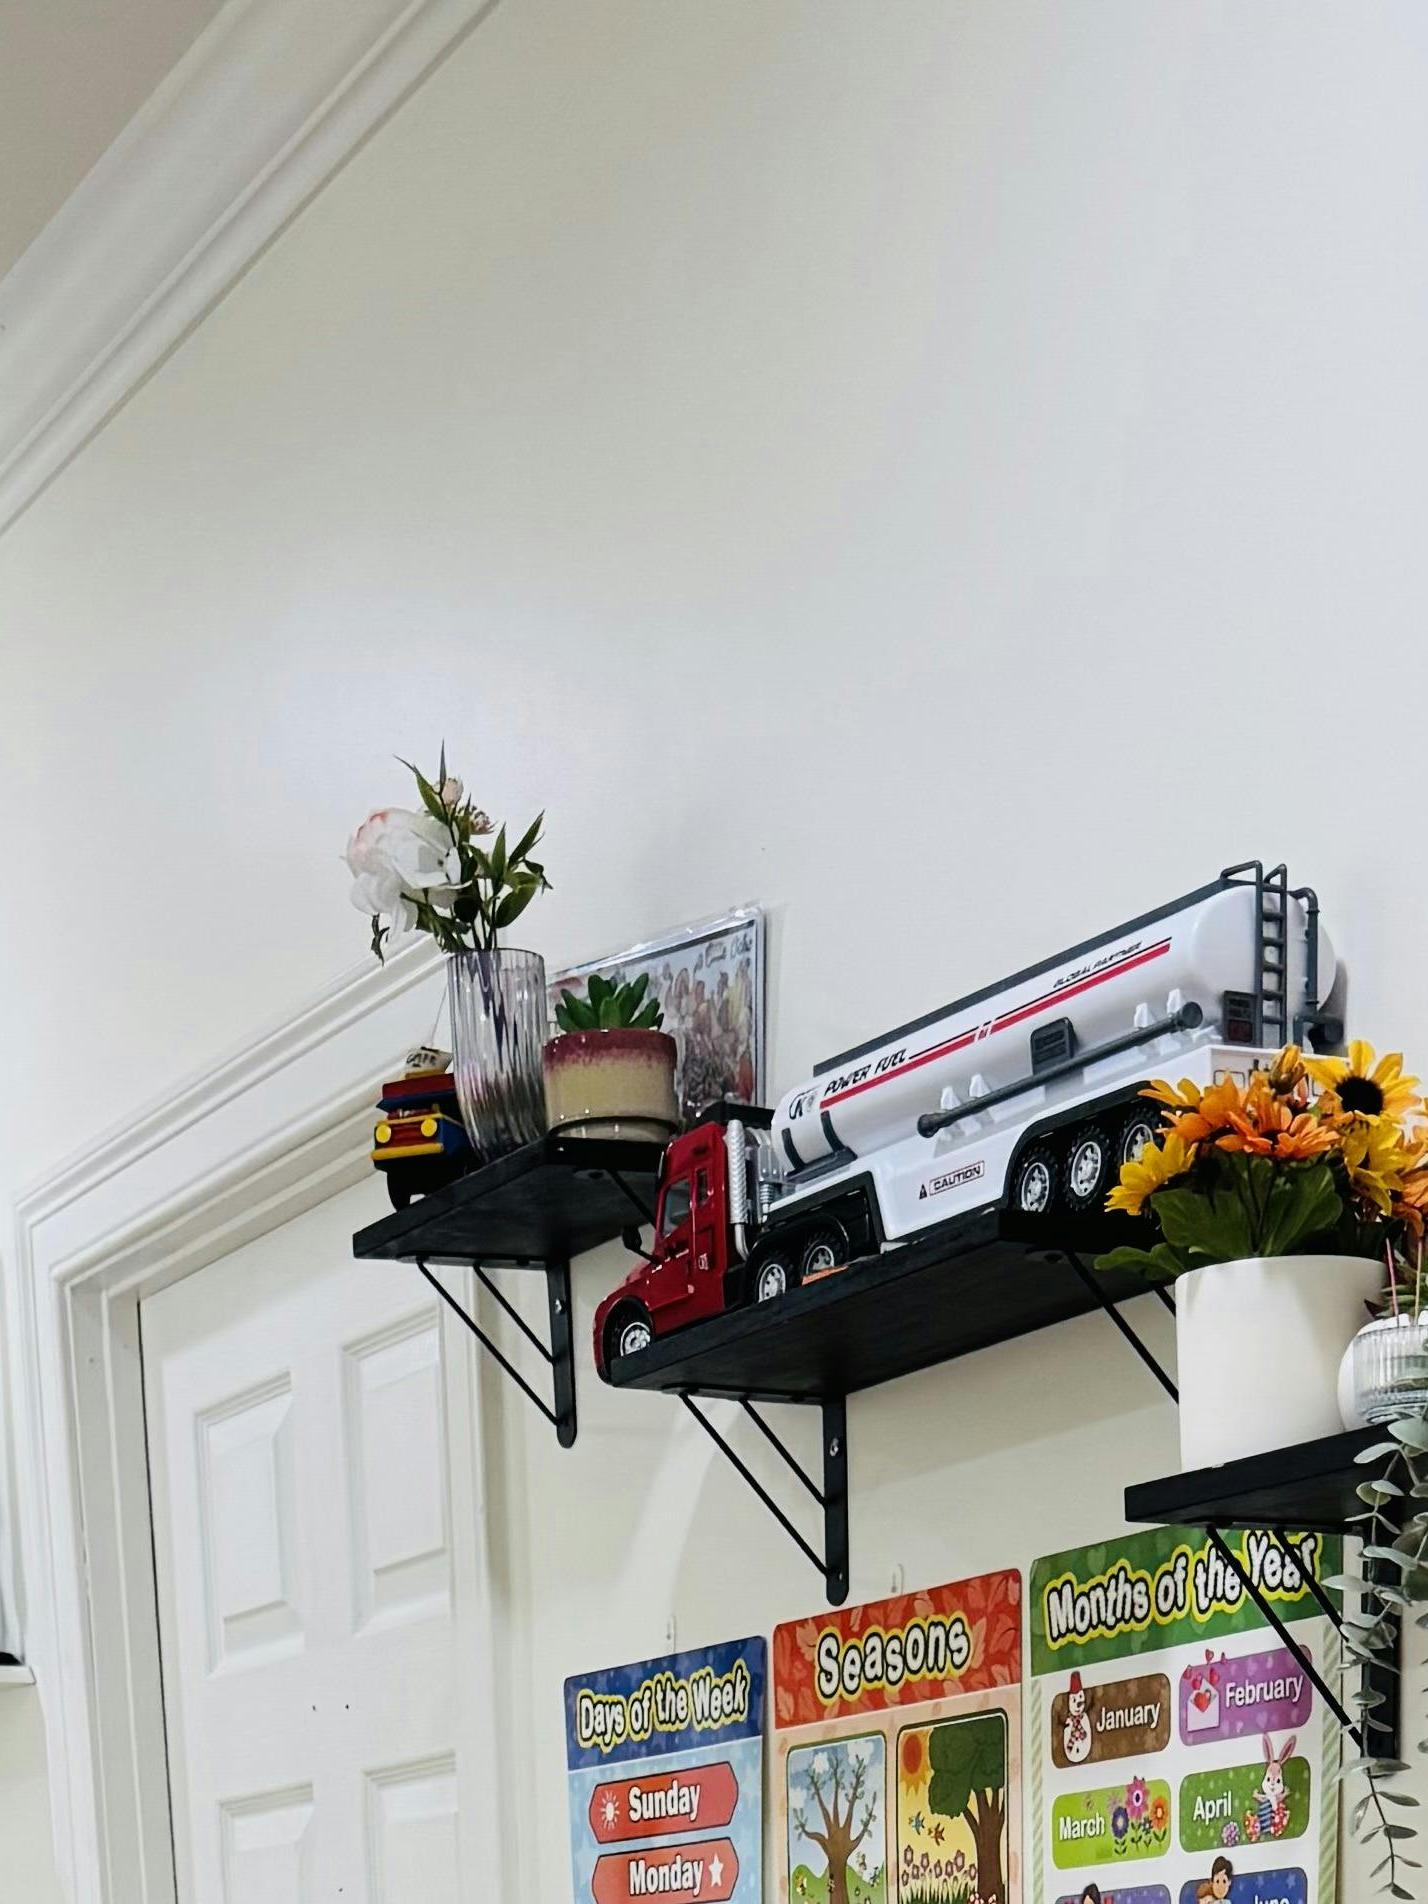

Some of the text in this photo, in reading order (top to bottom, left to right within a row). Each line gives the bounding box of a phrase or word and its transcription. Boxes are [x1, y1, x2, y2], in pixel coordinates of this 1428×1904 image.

[824, 1048, 907, 1096] POWER FUEL
[933, 1165, 981, 1191] CAUTION
[1047, 1532, 1318, 1642] Months of the Year
[818, 1616, 970, 1700] Seasons
[580, 1664, 748, 1746] Days of the Week
[1225, 1675, 1305, 1709] February
[1096, 1702, 1161, 1733] January
[628, 1780, 701, 1823] Sunday
[1193, 1791, 1232, 1827] April
[1059, 1813, 1106, 1842] March
[629, 1855, 705, 1897] Monday
